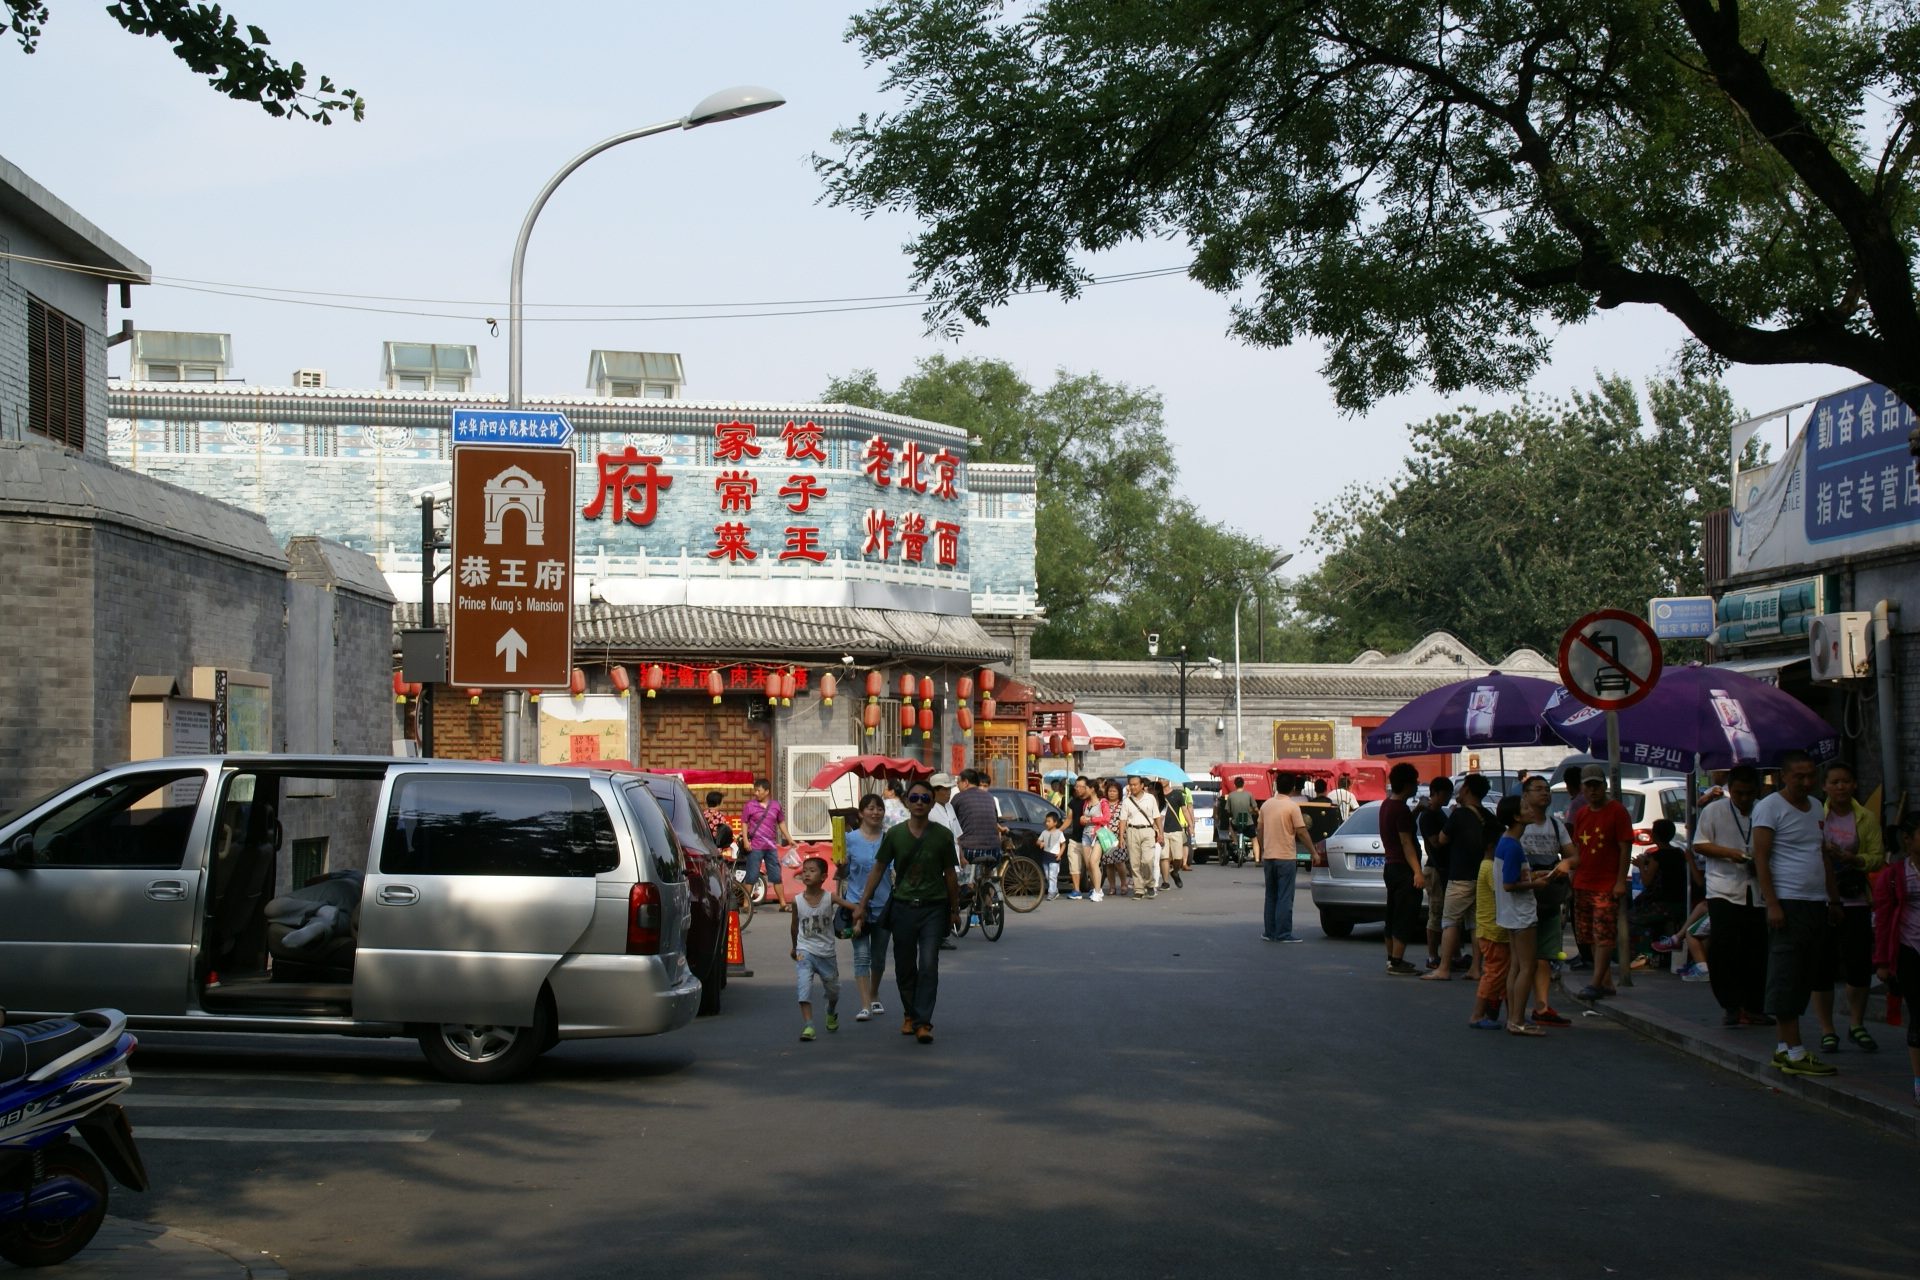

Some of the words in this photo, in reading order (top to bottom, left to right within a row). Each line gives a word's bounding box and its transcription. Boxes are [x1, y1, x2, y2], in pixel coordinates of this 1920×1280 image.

[458, 418, 559, 438] 兴华府四合院餐饮会馆
[860, 434, 961, 501] 老北京
[582, 446, 674, 526] 府
[1816, 458, 1920, 526] 指定专营店
[860, 508, 961, 567] 炸酱面
[459, 556, 566, 591] 恭王府
[459, 596, 487, 611] Prince
[490, 596, 523, 615] Kung's
[526, 597, 565, 613] Mansion
[1394, 731, 1422, 745] 百岁山
[1634, 743, 1682, 763] 百岁山
